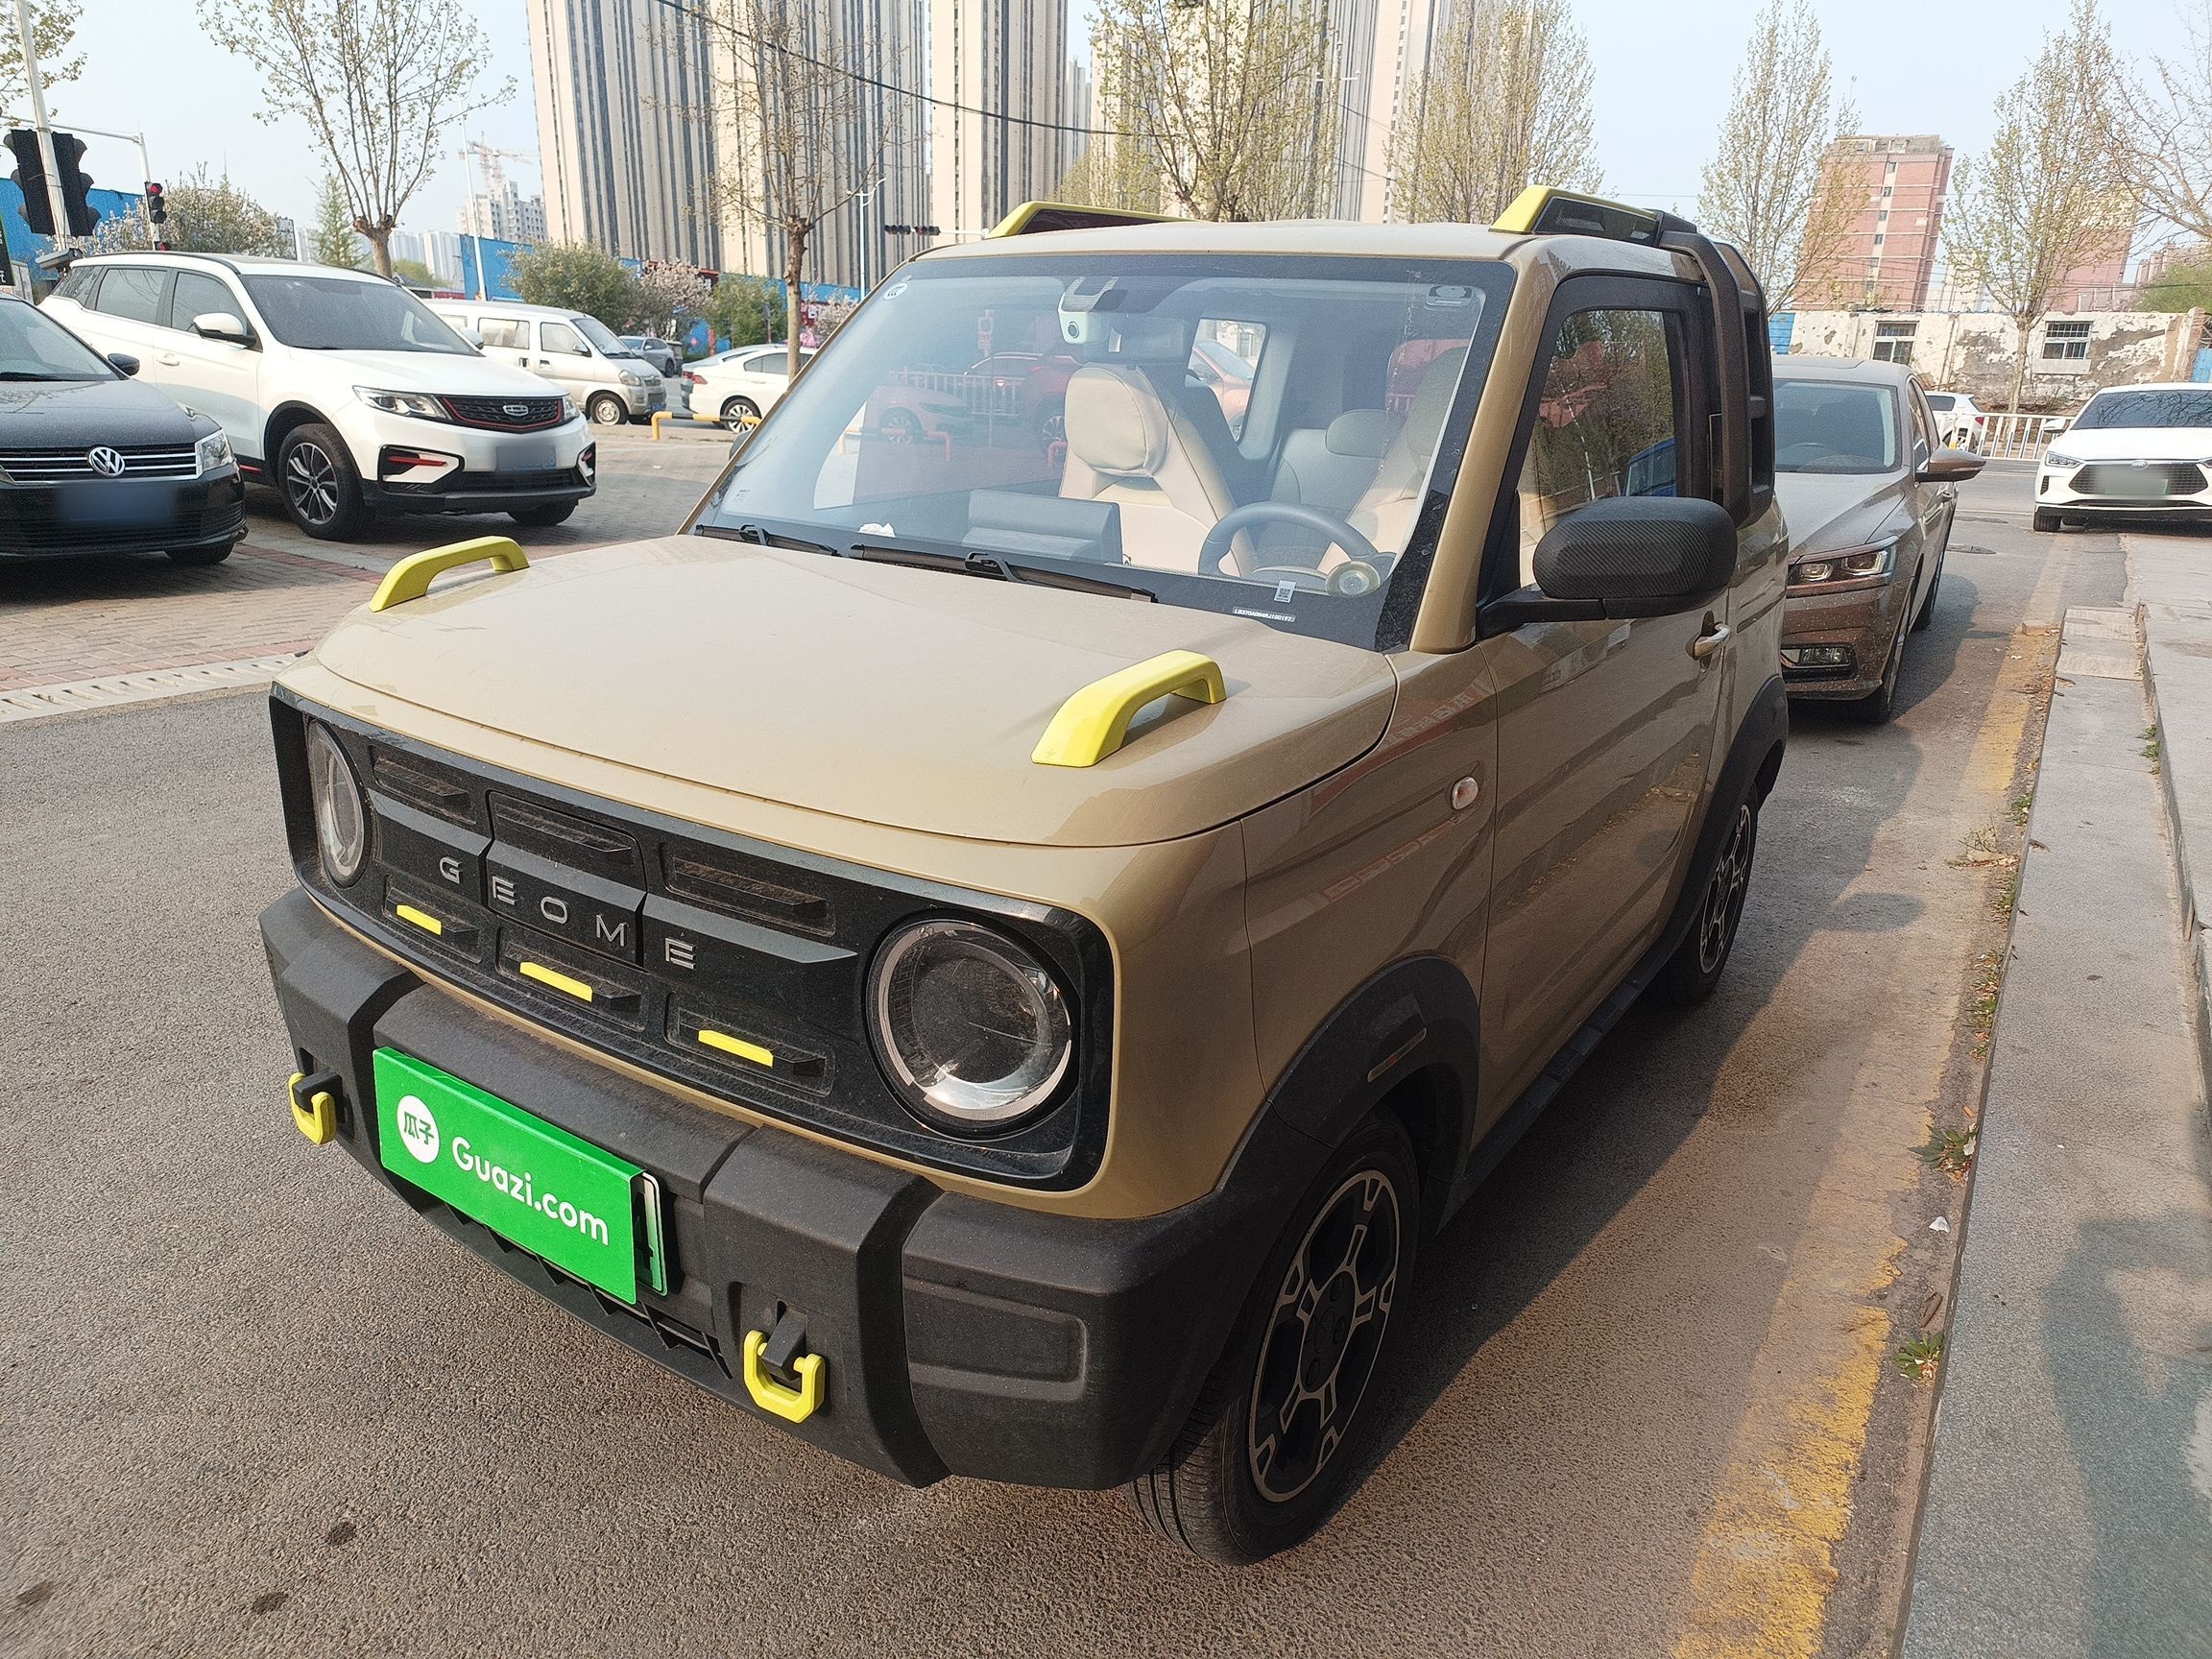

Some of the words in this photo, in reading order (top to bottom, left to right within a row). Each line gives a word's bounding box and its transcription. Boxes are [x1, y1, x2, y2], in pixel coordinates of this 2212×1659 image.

[439, 855, 697, 970] GEOME
[403, 1111, 435, 1145] 瓜子
[451, 1136, 610, 1246] Guazi.com
